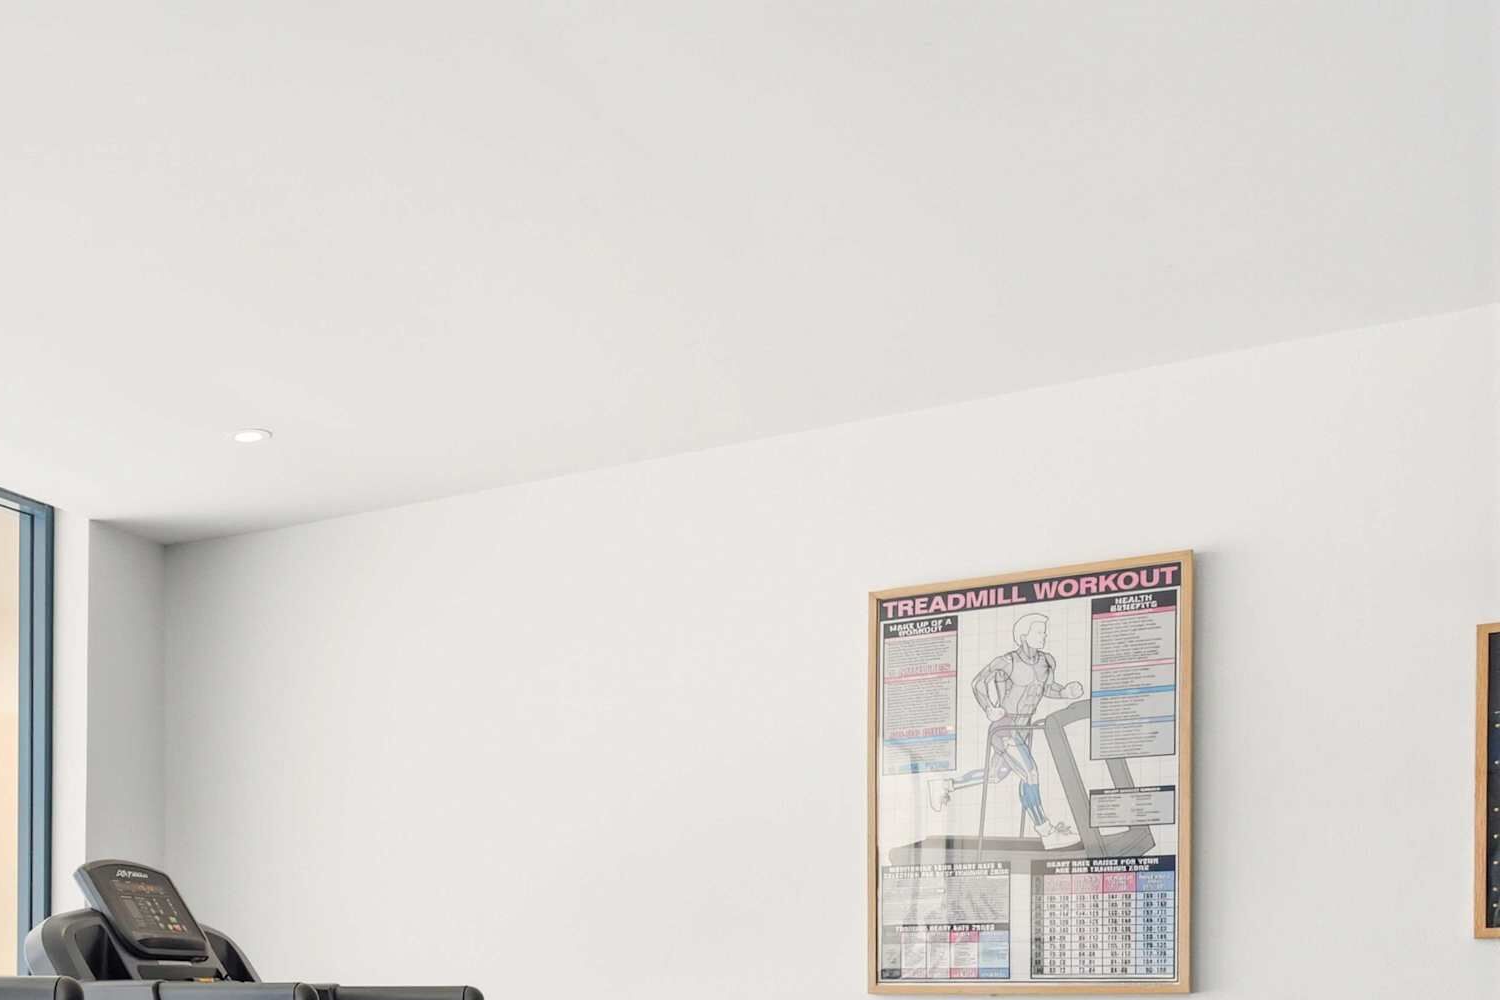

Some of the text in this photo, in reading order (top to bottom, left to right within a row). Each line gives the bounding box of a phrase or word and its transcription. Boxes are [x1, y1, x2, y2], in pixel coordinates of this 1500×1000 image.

[882, 566, 1179, 619] TREADMILL WORKOUT
[1115, 594, 1153, 604] HEALTH
[945, 618, 952, 626] A
